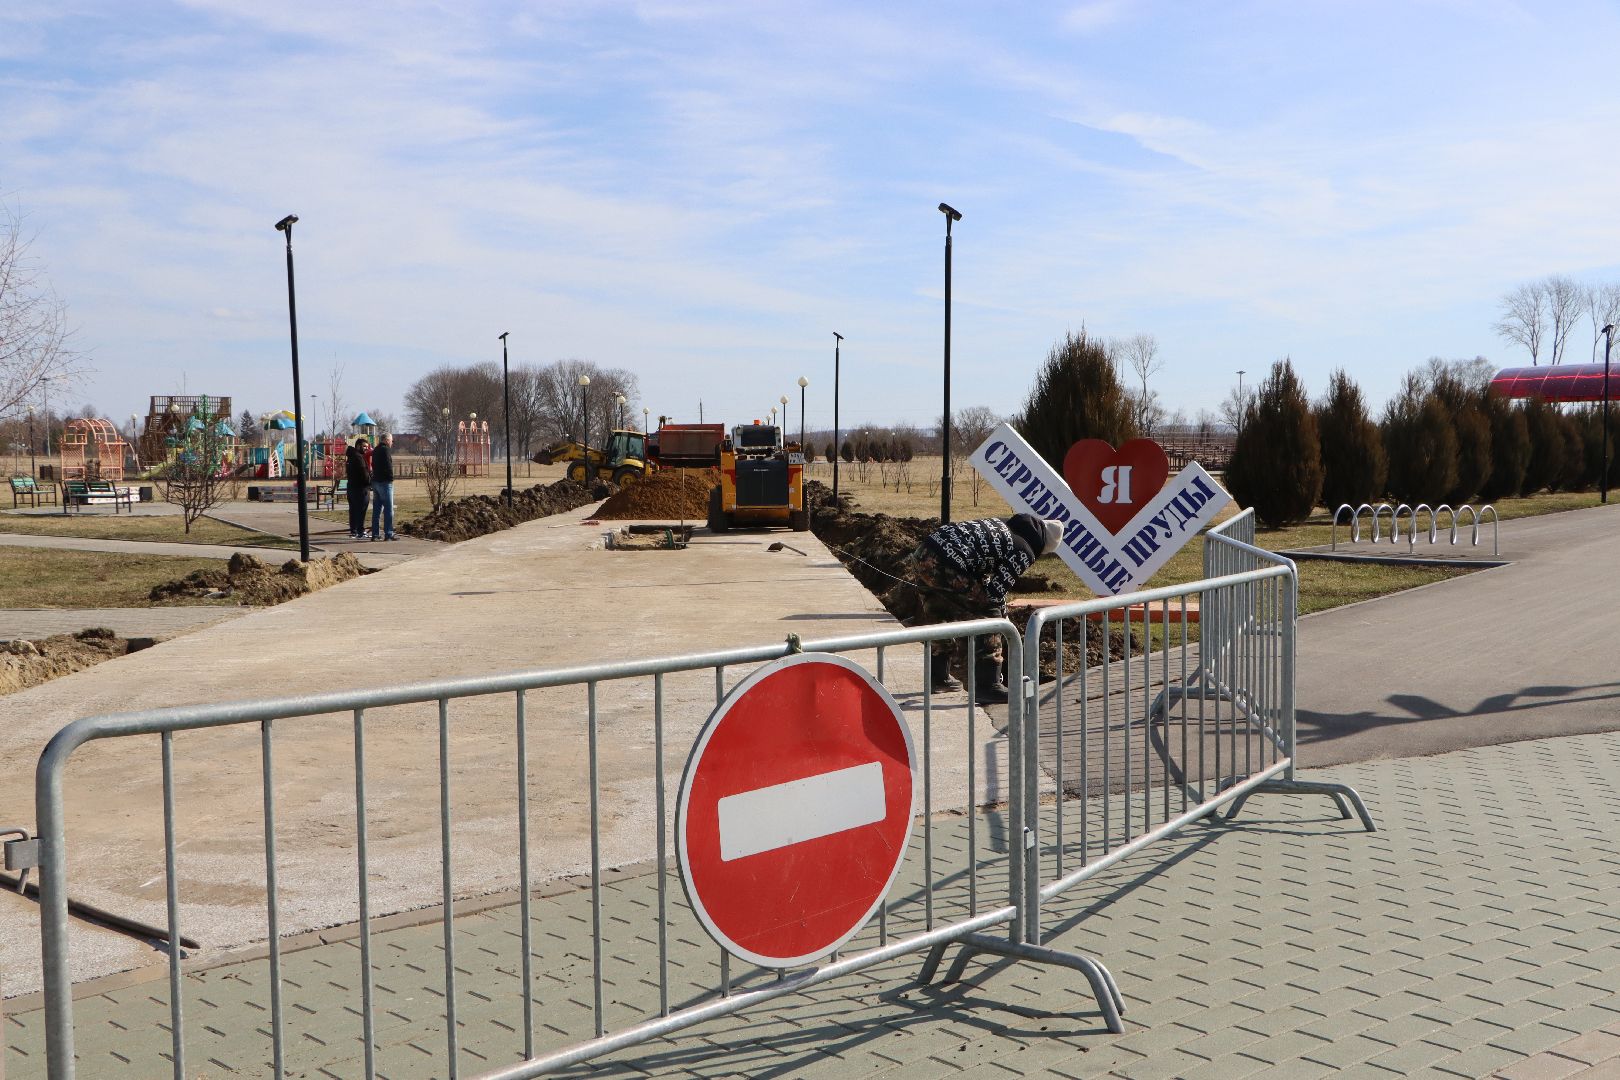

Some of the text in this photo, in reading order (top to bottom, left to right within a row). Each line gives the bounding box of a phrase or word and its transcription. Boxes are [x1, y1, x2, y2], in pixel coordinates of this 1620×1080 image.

[984, 441, 1134, 595] СЕРЕБРЯНЫЕ
[1097, 465, 1133, 504] Я
[1120, 476, 1217, 568] ПРУДЫ
